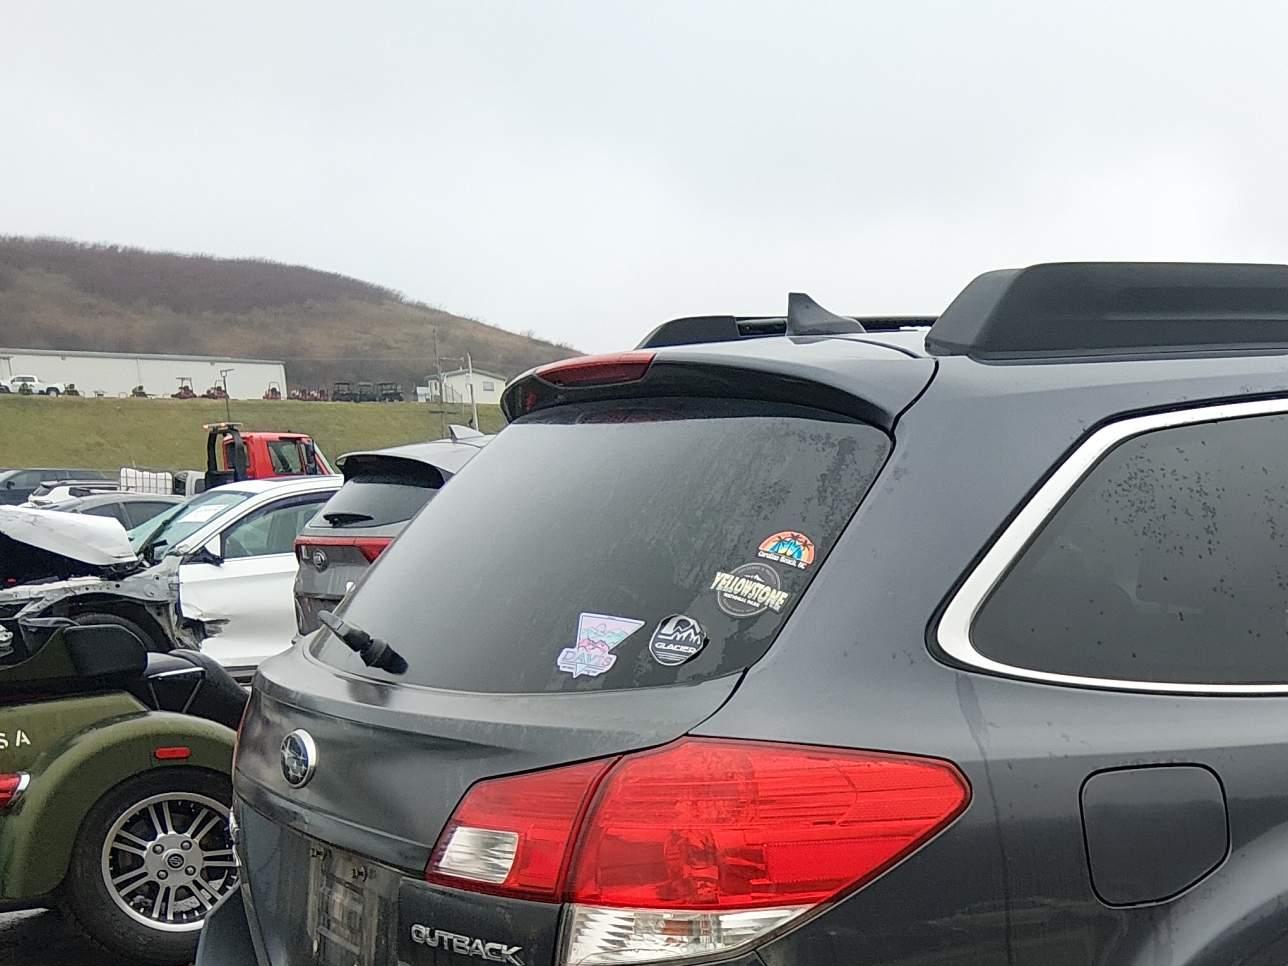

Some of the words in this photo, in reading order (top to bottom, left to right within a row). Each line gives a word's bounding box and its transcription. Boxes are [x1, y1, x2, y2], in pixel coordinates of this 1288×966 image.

[710, 571, 789, 611] YELLOWSTONE
[654, 642, 697, 653] GLACIER
[411, 923, 526, 966] OUTBACK
